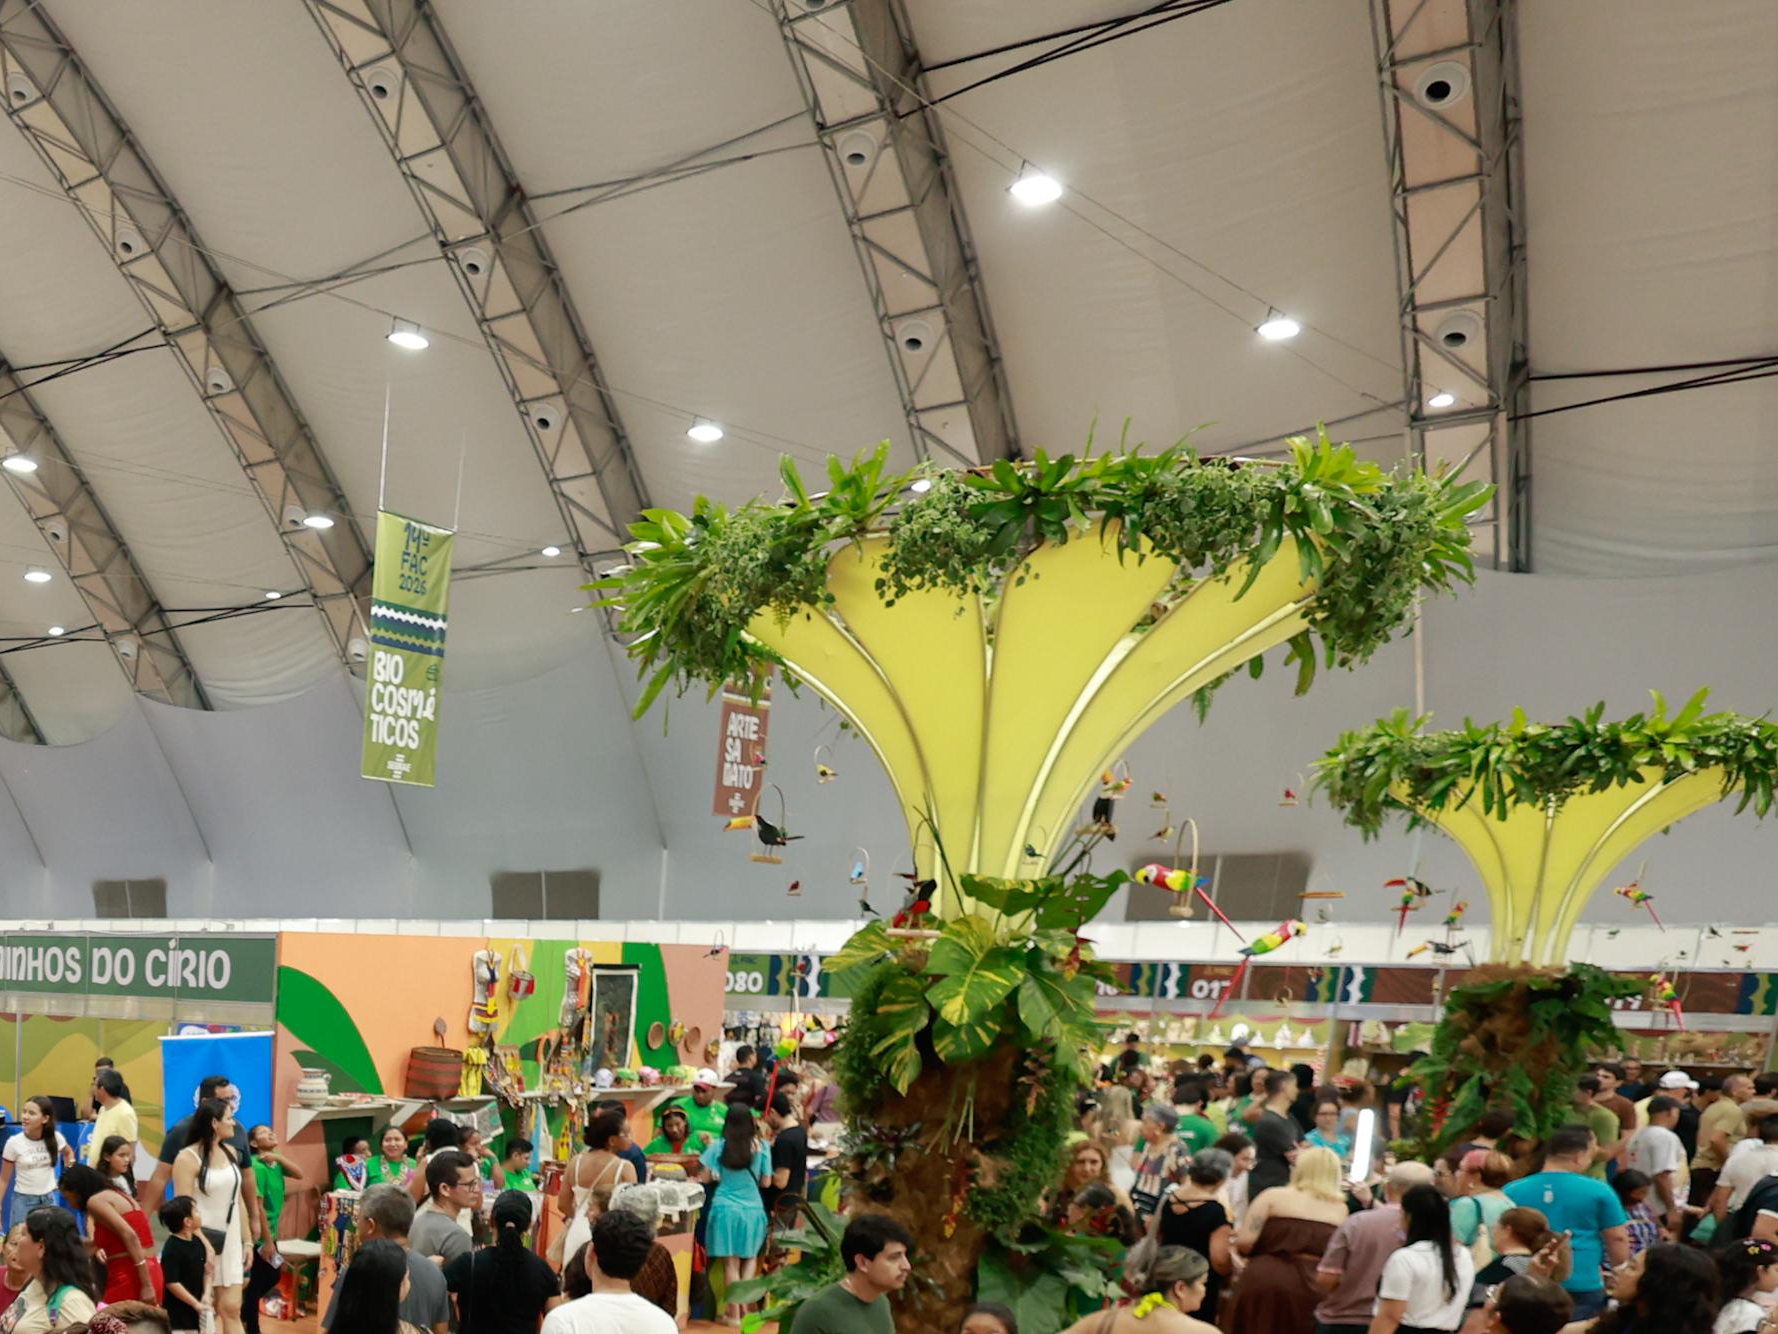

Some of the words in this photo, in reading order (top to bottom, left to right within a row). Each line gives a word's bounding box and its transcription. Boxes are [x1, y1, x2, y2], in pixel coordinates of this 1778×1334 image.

[402, 550, 428, 576] FAC
[399, 574, 428, 596] 2026
[373, 651, 403, 685] BIO
[371, 713, 419, 750] TICOS
[727, 712, 759, 741] ARTE
[725, 737, 742, 763] SA
[92, 948, 135, 986] DO
[145, 939, 231, 990] CÍRIO
